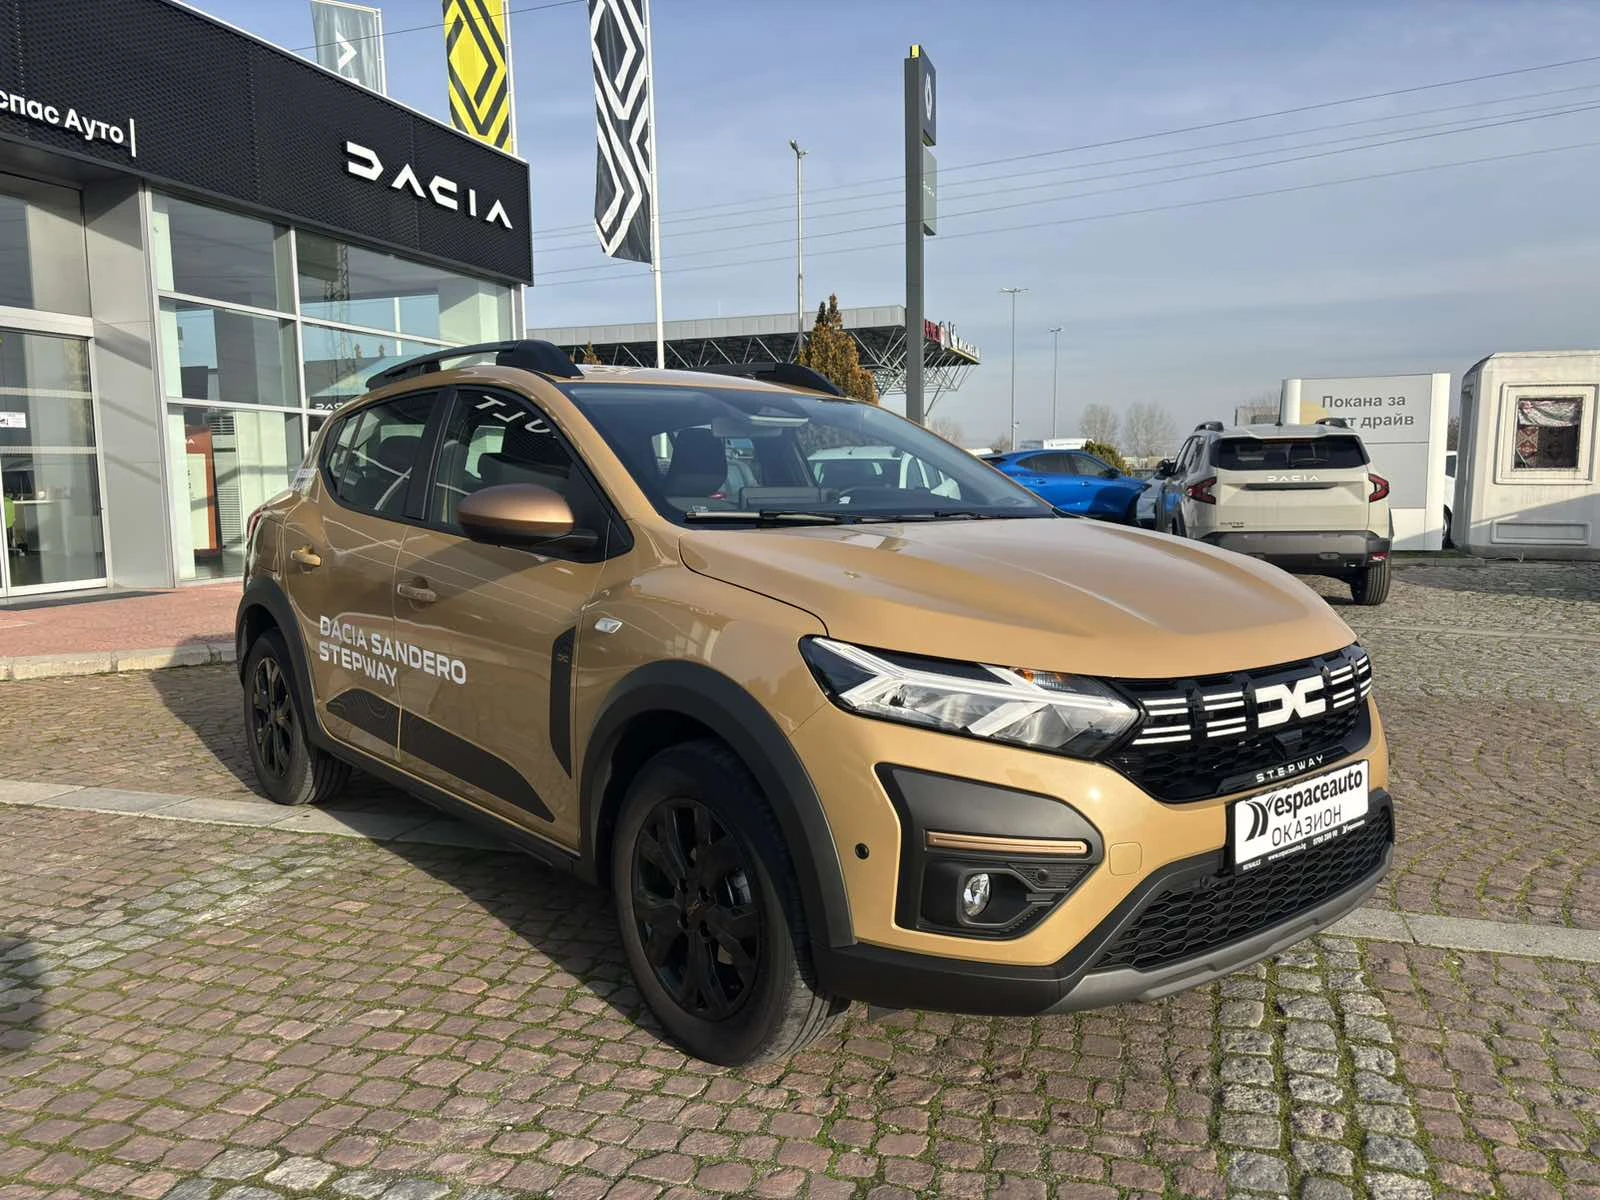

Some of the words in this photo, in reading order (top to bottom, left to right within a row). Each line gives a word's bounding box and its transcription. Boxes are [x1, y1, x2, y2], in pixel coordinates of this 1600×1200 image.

[64, 108, 124, 144] Ауто
[346, 141, 513, 229] DACIA
[1322, 395, 1382, 408] Покана
[1387, 396, 1406, 406] за
[1360, 412, 1414, 429] драйв
[319, 641, 397, 687] STEPWAY
[320, 615, 368, 650] DACIA
[371, 633, 466, 685] SANDERO
[1256, 755, 1323, 783] STEPWAY
[1274, 769, 1363, 819] espaceauto
[1272, 804, 1341, 847] ОКАЗИОН
